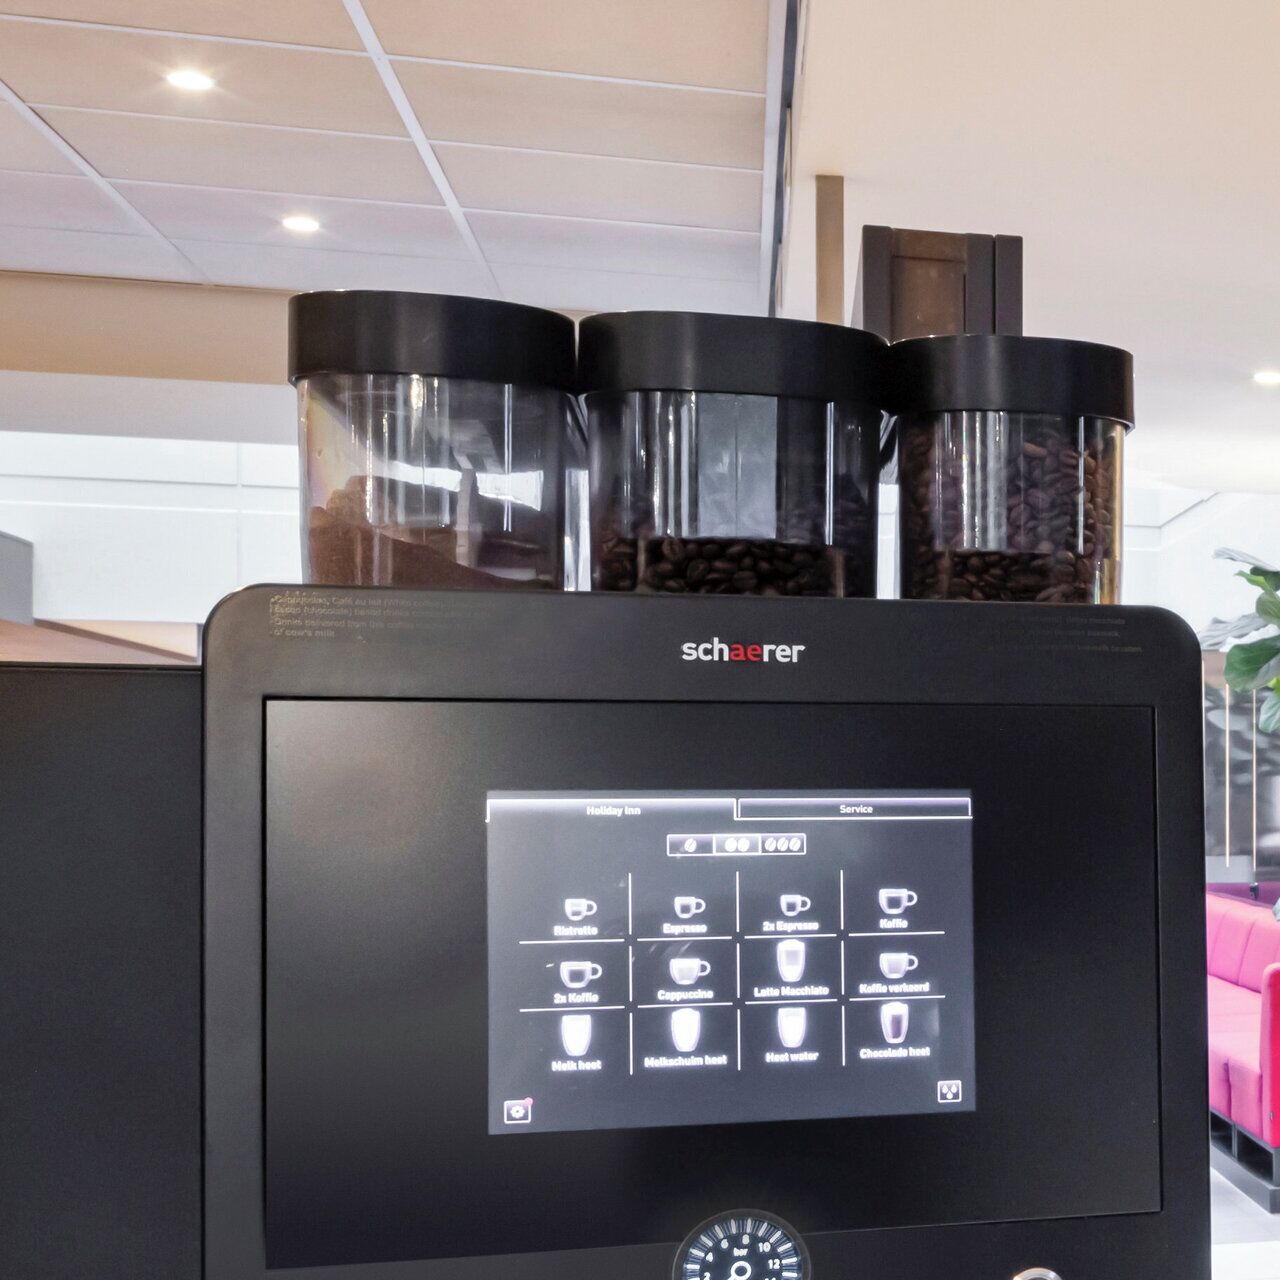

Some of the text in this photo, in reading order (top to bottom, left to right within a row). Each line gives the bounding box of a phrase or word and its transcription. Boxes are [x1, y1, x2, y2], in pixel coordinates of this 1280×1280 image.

[681, 636, 806, 663] schaerer
[586, 805, 641, 817] Holiday Inn
[840, 804, 874, 814] Service
[662, 923, 708, 935] Espresso
[762, 921, 819, 932] 2x Espresso
[880, 918, 908, 929] Koffie
[754, 985, 830, 998] Latte Macchiato
[859, 983, 888, 994] Koffie
[554, 992, 599, 1004] 2x Koffie
[657, 989, 714, 1002] Cappuccino
[790, 1052, 820, 1062] water
[860, 1048, 908, 1060] Chocolade
[552, 1060, 578, 1072] Melk
[644, 1056, 704, 1068] Melkschuim
[720, 1238, 729, 1249] 6
[758, 1241, 771, 1253] 10
[706, 1252, 714, 1262] 4
[768, 1258, 780, 1270] 12
